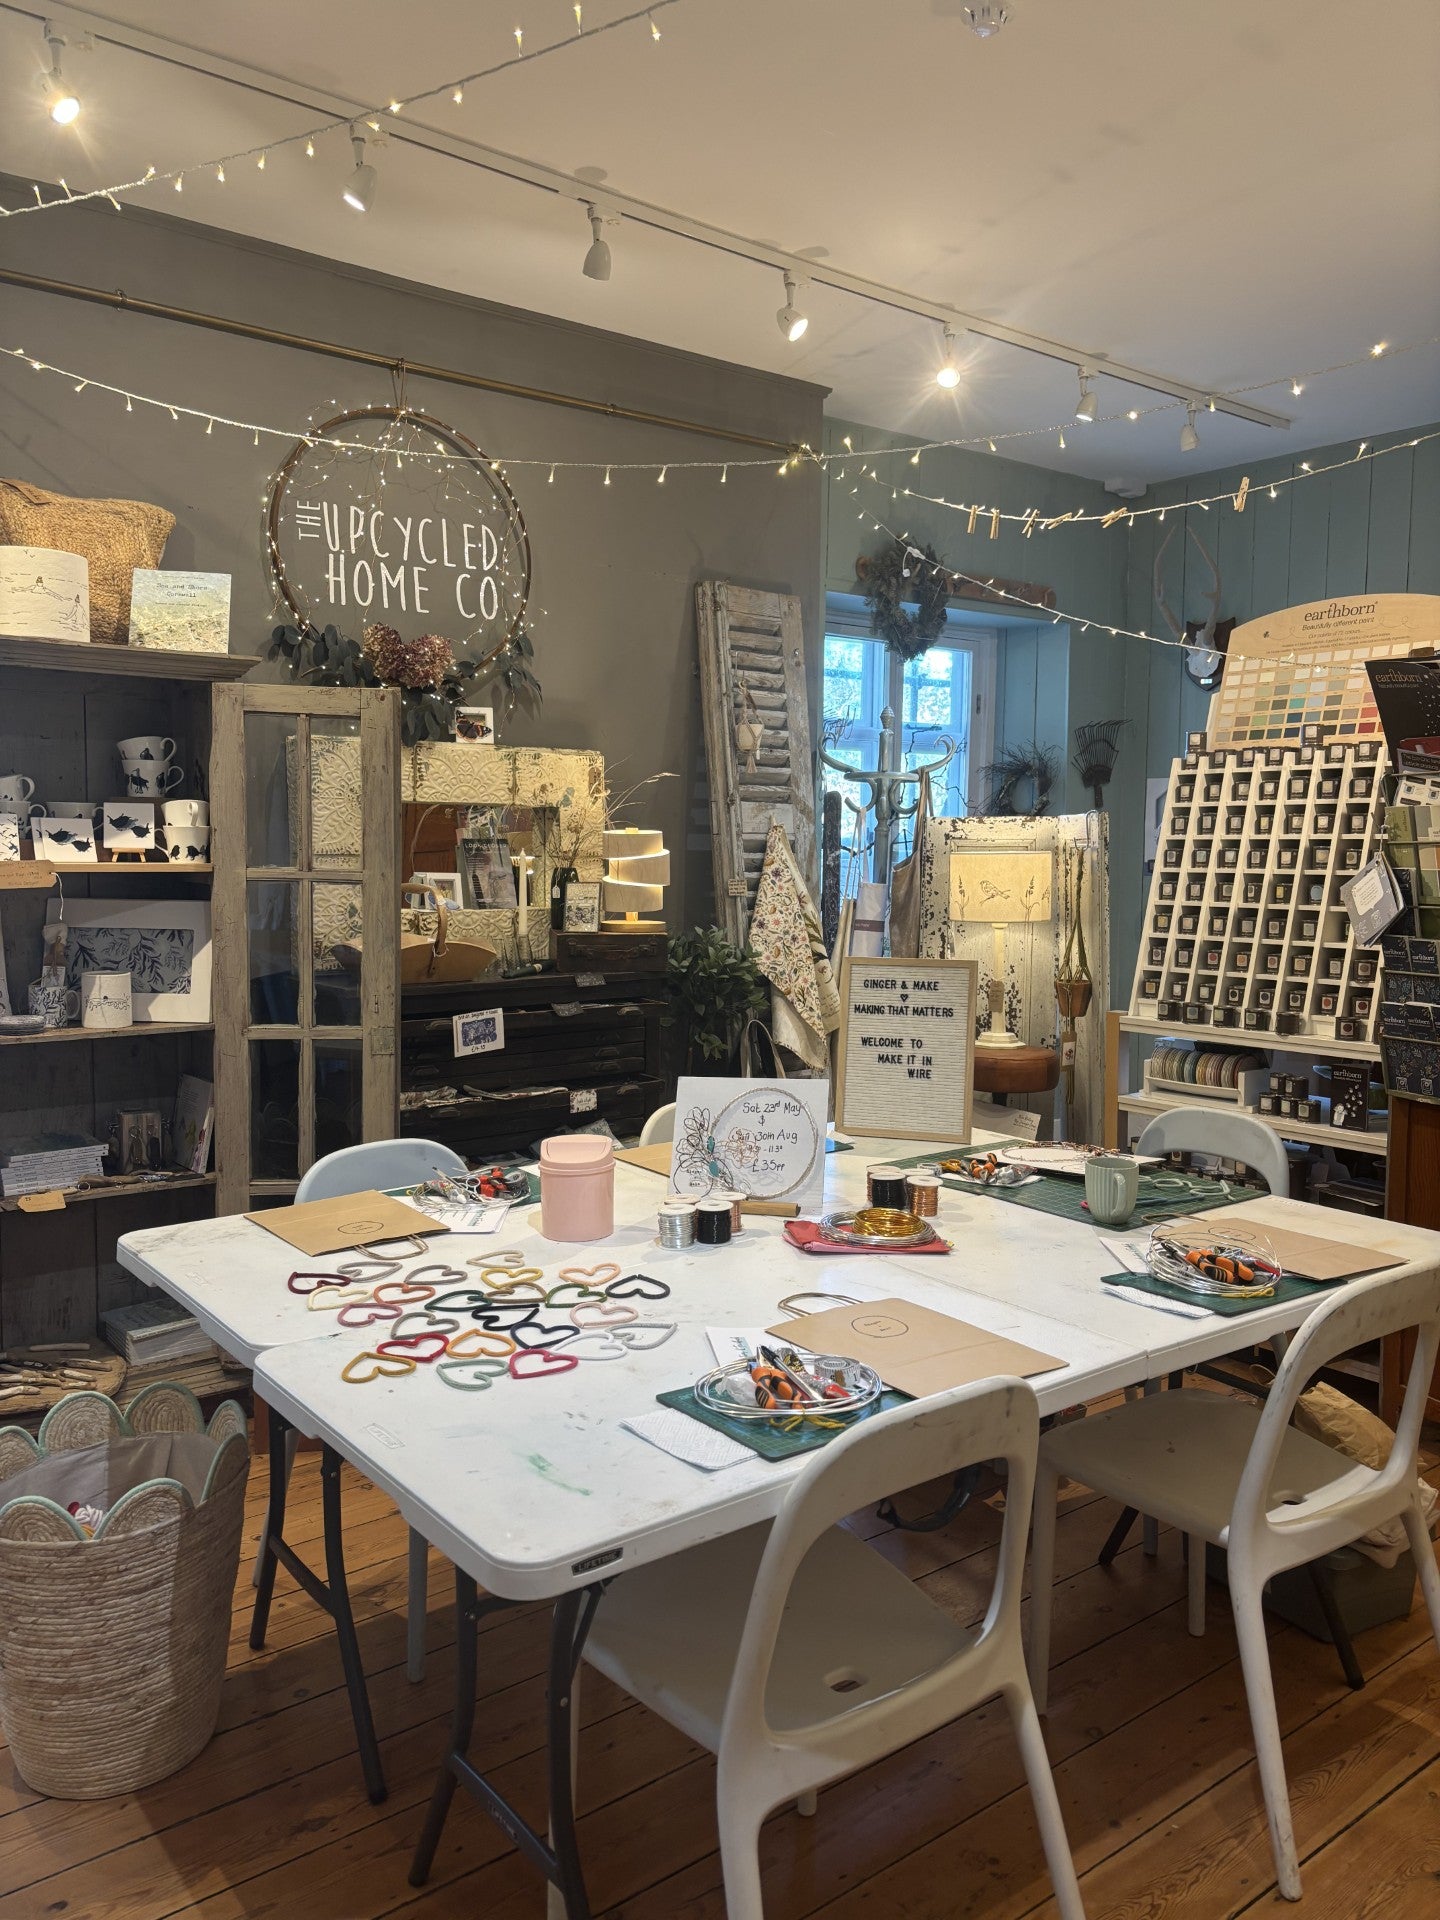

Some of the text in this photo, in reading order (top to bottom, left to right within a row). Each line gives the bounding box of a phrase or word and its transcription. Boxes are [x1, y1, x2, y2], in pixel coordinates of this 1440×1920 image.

[296, 500, 498, 570] THE UPCYCLED
[329, 553, 498, 620] HOME CO
[1304, 602, 1375, 622] earthborn
[1376, 669, 1421, 683] earthborn
[863, 979, 939, 991] GINGER & MAKE
[854, 1004, 885, 1015] MAKING
[887, 1005, 909, 1016] THAT
[912, 1006, 954, 1018] MATTERS
[861, 1036, 923, 1049] WELCOME TO
[877, 1054, 932, 1066] MAKE IT IN
[907, 1068, 932, 1079] WIRE
[743, 1102, 761, 1114] Sat
[783, 1102, 801, 1117] May
[776, 1129, 798, 1145] Aug
